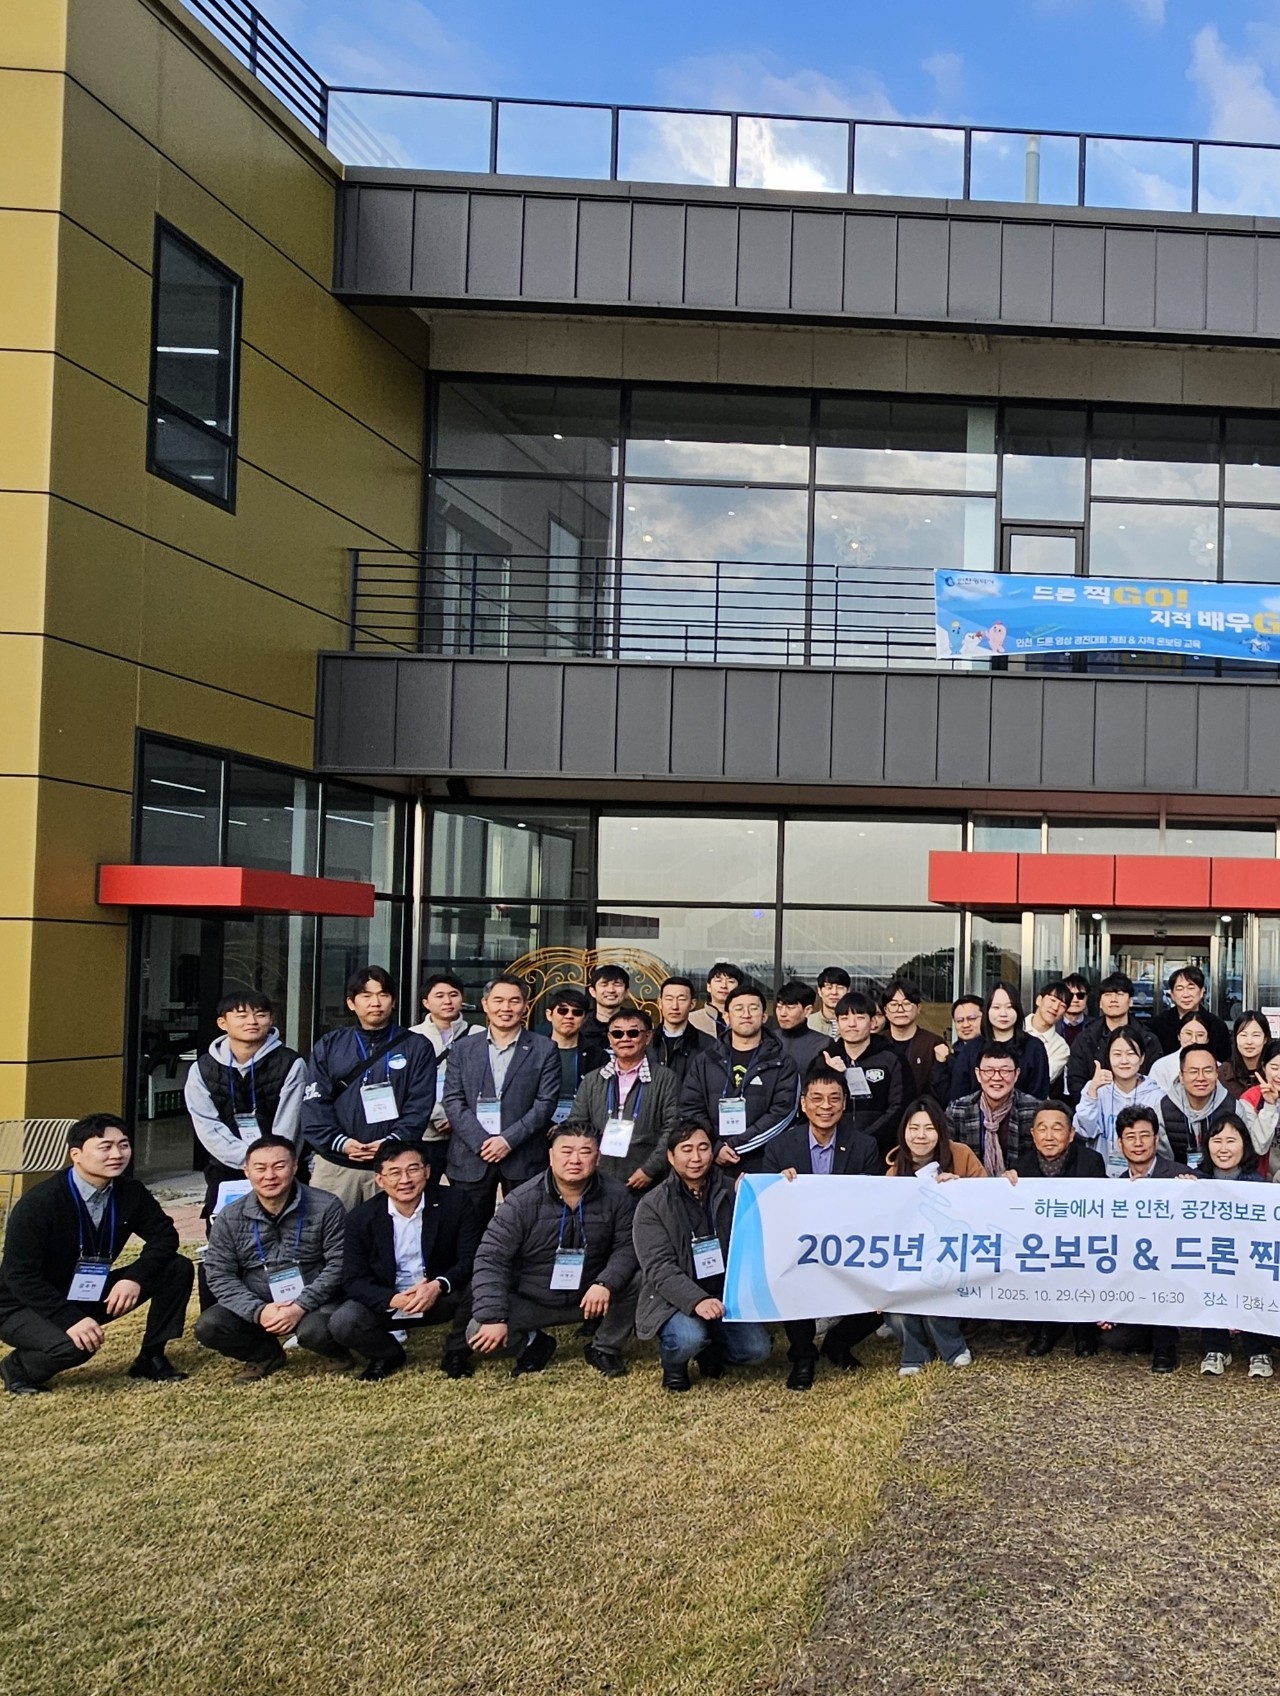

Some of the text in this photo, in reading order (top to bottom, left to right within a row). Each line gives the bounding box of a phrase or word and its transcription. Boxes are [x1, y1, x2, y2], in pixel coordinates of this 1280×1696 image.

[1033, 585, 1188, 609] 드론 찍GO!
[1149, 611, 1191, 629] 지적
[1016, 635, 1201, 649] 인천 드론 영상 경진대회 개최 & 지적 온보딩 교육
[1035, 1199, 1104, 1218] 하늘에서
[1111, 1200, 1129, 1218] 본
[1136, 1200, 1174, 1220] 인천,
[1181, 1200, 1267, 1222] 공간정보로
[797, 1232, 924, 1272] 2025년
[936, 1232, 1002, 1273] 지적
[1014, 1232, 1117, 1274] 온보딩
[1133, 1238, 1160, 1271] &
[1171, 1237, 1239, 1276] 드론
[956, 1286, 982, 1300] 일시
[998, 1288, 1028, 1300] 2025.
[1035, 1290, 1051, 1301] 10.
[1100, 1290, 1134, 1302] 09:00
[1152, 1292, 1184, 1303] 16:30
[1203, 1292, 1228, 1306] 장소
[1243, 1296, 1264, 1311] 강화
